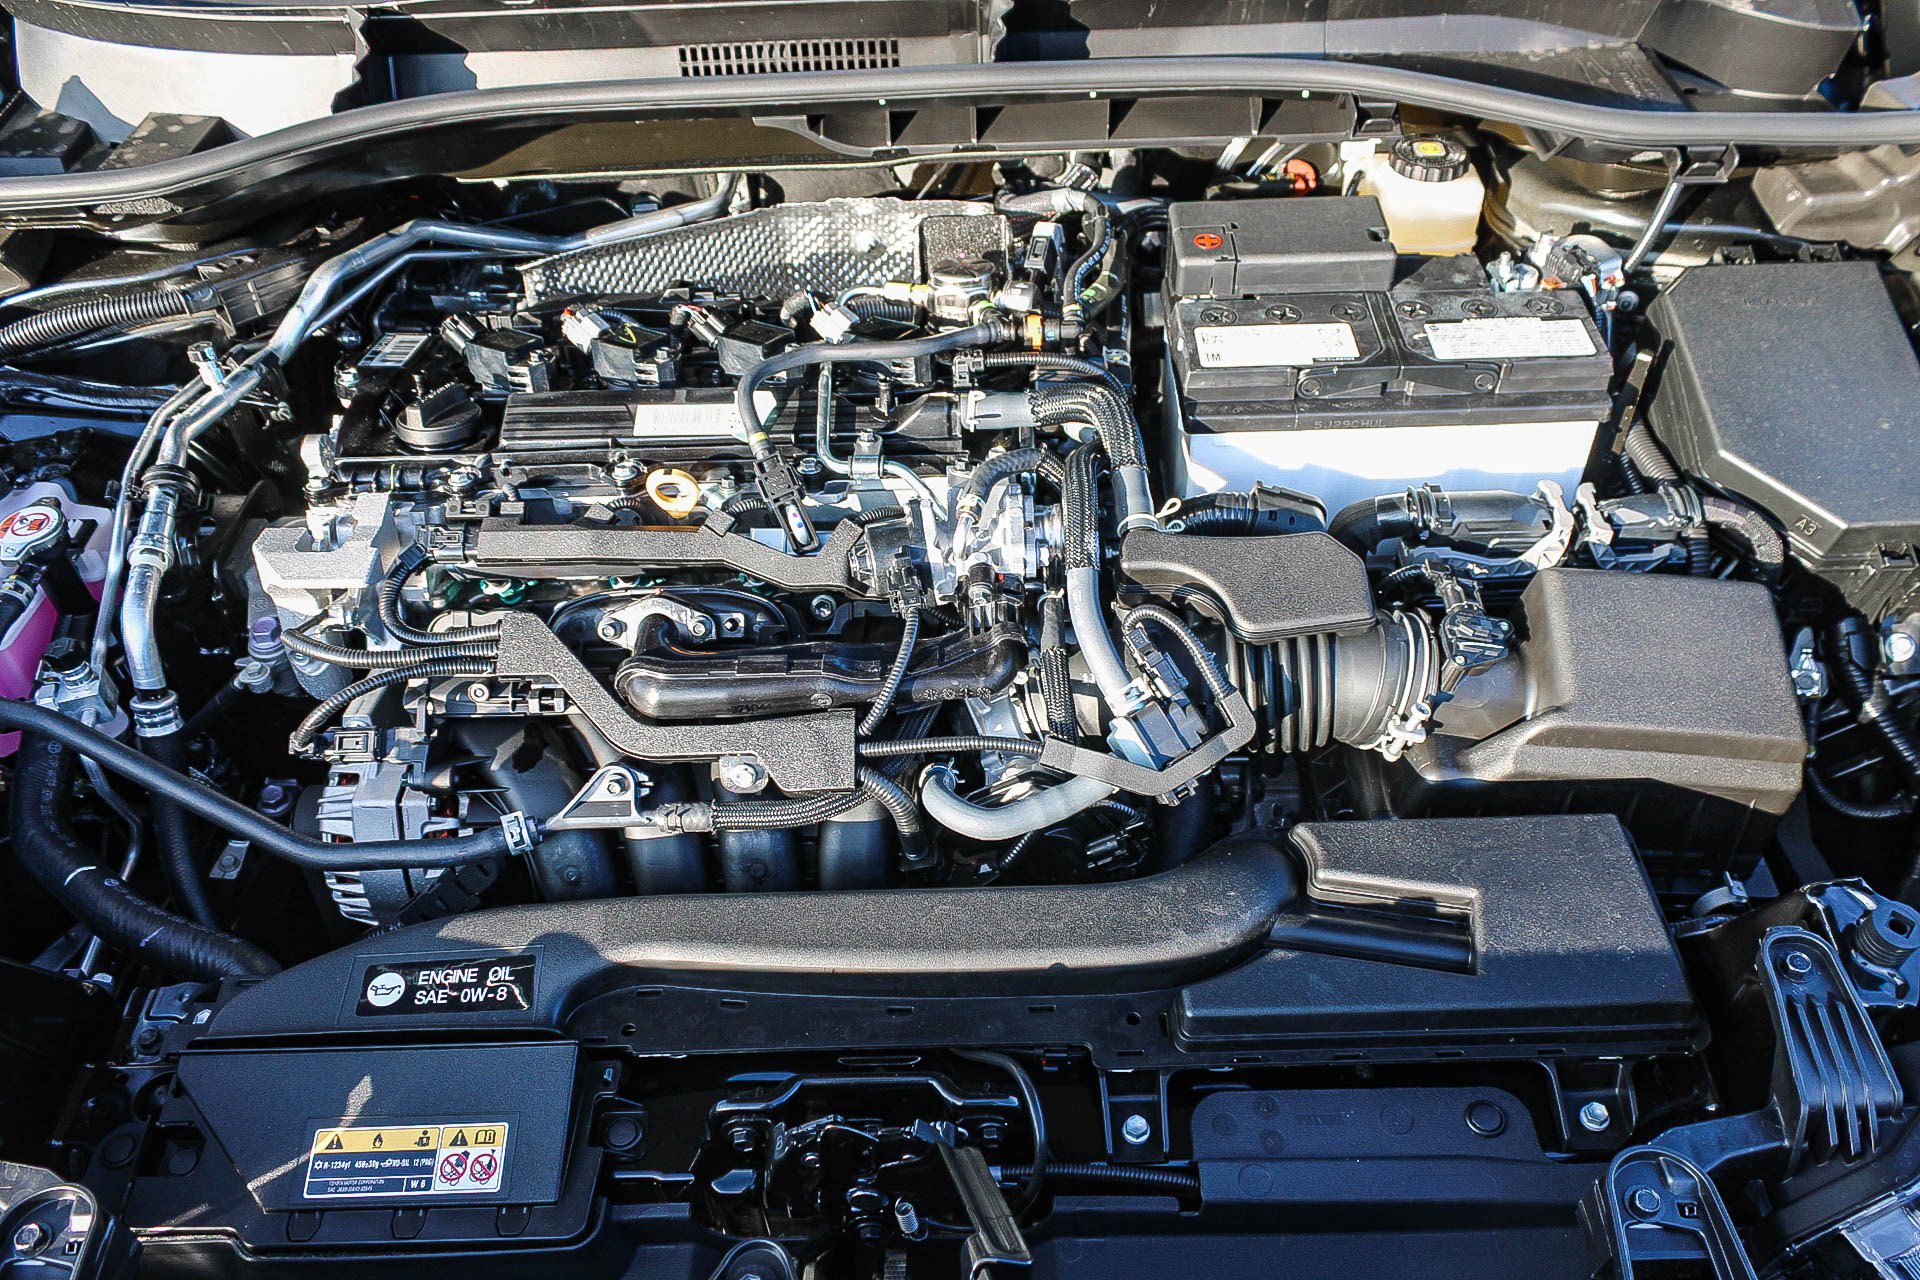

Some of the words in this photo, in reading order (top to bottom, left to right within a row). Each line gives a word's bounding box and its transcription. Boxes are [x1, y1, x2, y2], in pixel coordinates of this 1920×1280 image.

[1794, 518, 1817, 536] A3
[417, 967, 479, 986] ENGINE
[488, 966, 515, 982] OIL
[414, 989, 448, 1005] SAE
[460, 987, 508, 1003] 0W-8
